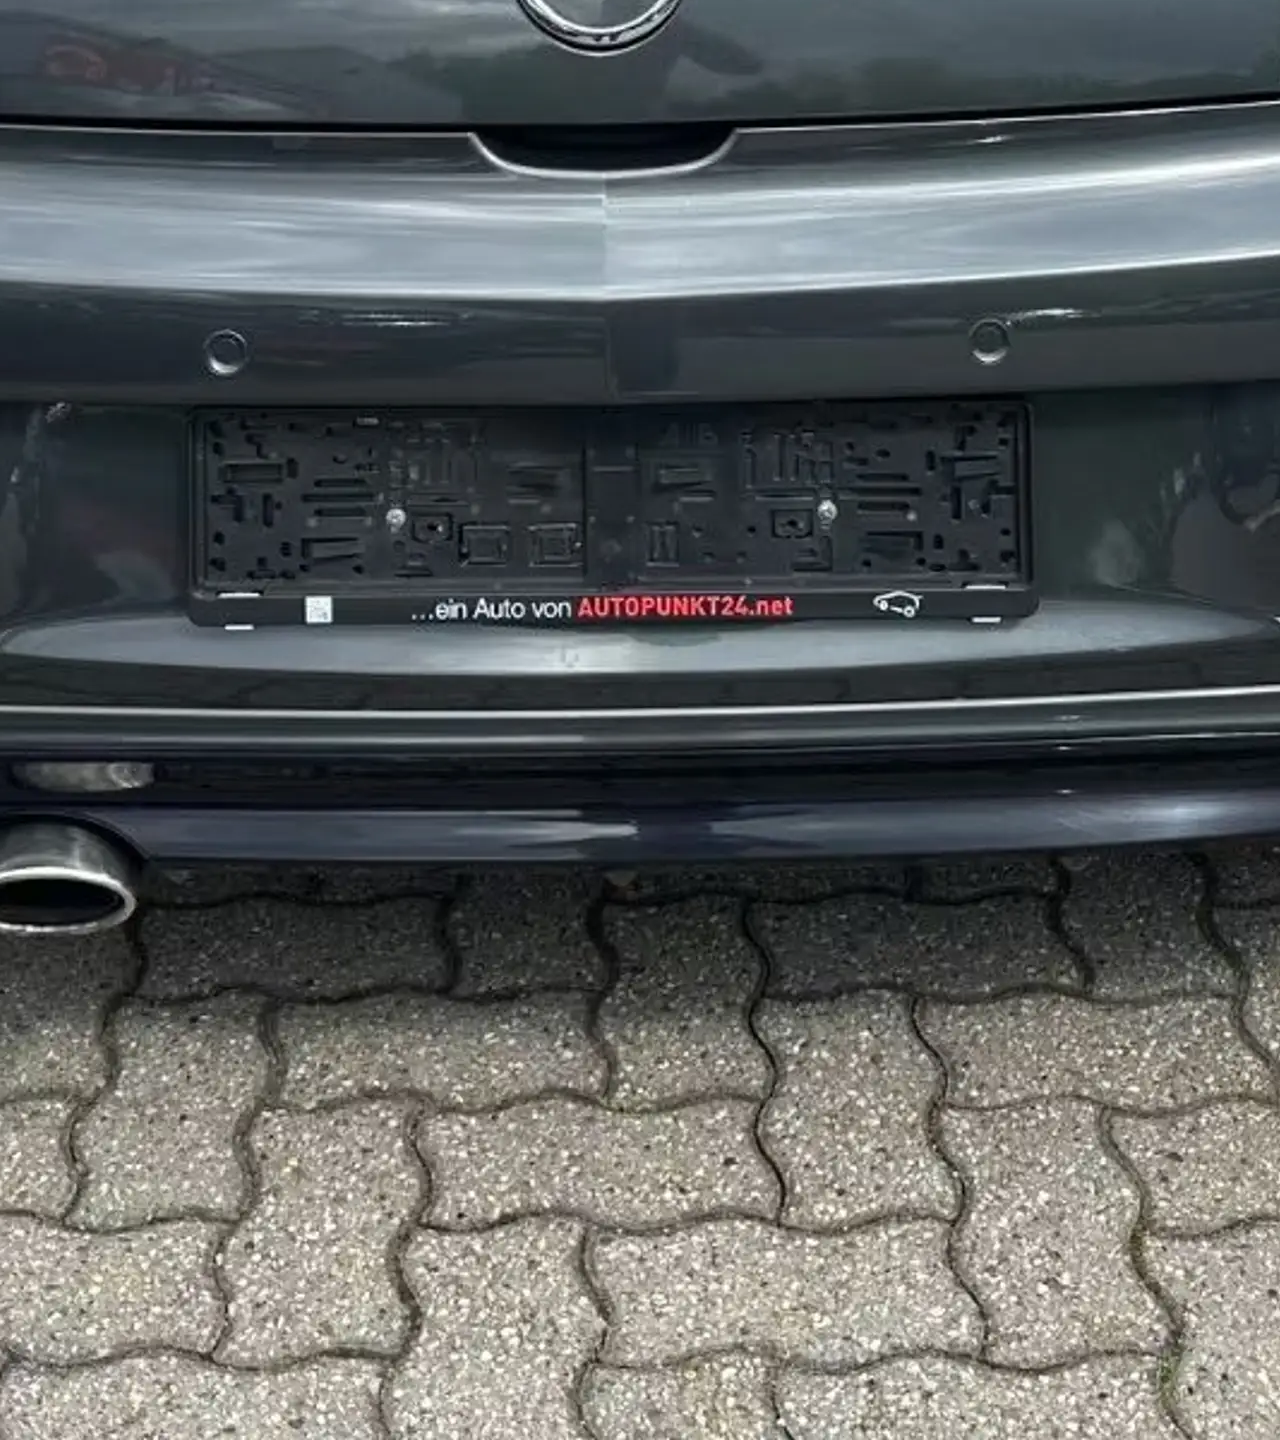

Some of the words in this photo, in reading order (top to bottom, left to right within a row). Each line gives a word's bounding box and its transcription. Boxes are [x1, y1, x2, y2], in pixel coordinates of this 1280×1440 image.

[472, 596, 526, 620] Auto
[532, 599, 572, 619] von
[577, 595, 794, 617] AUTOPUNKT24.net
